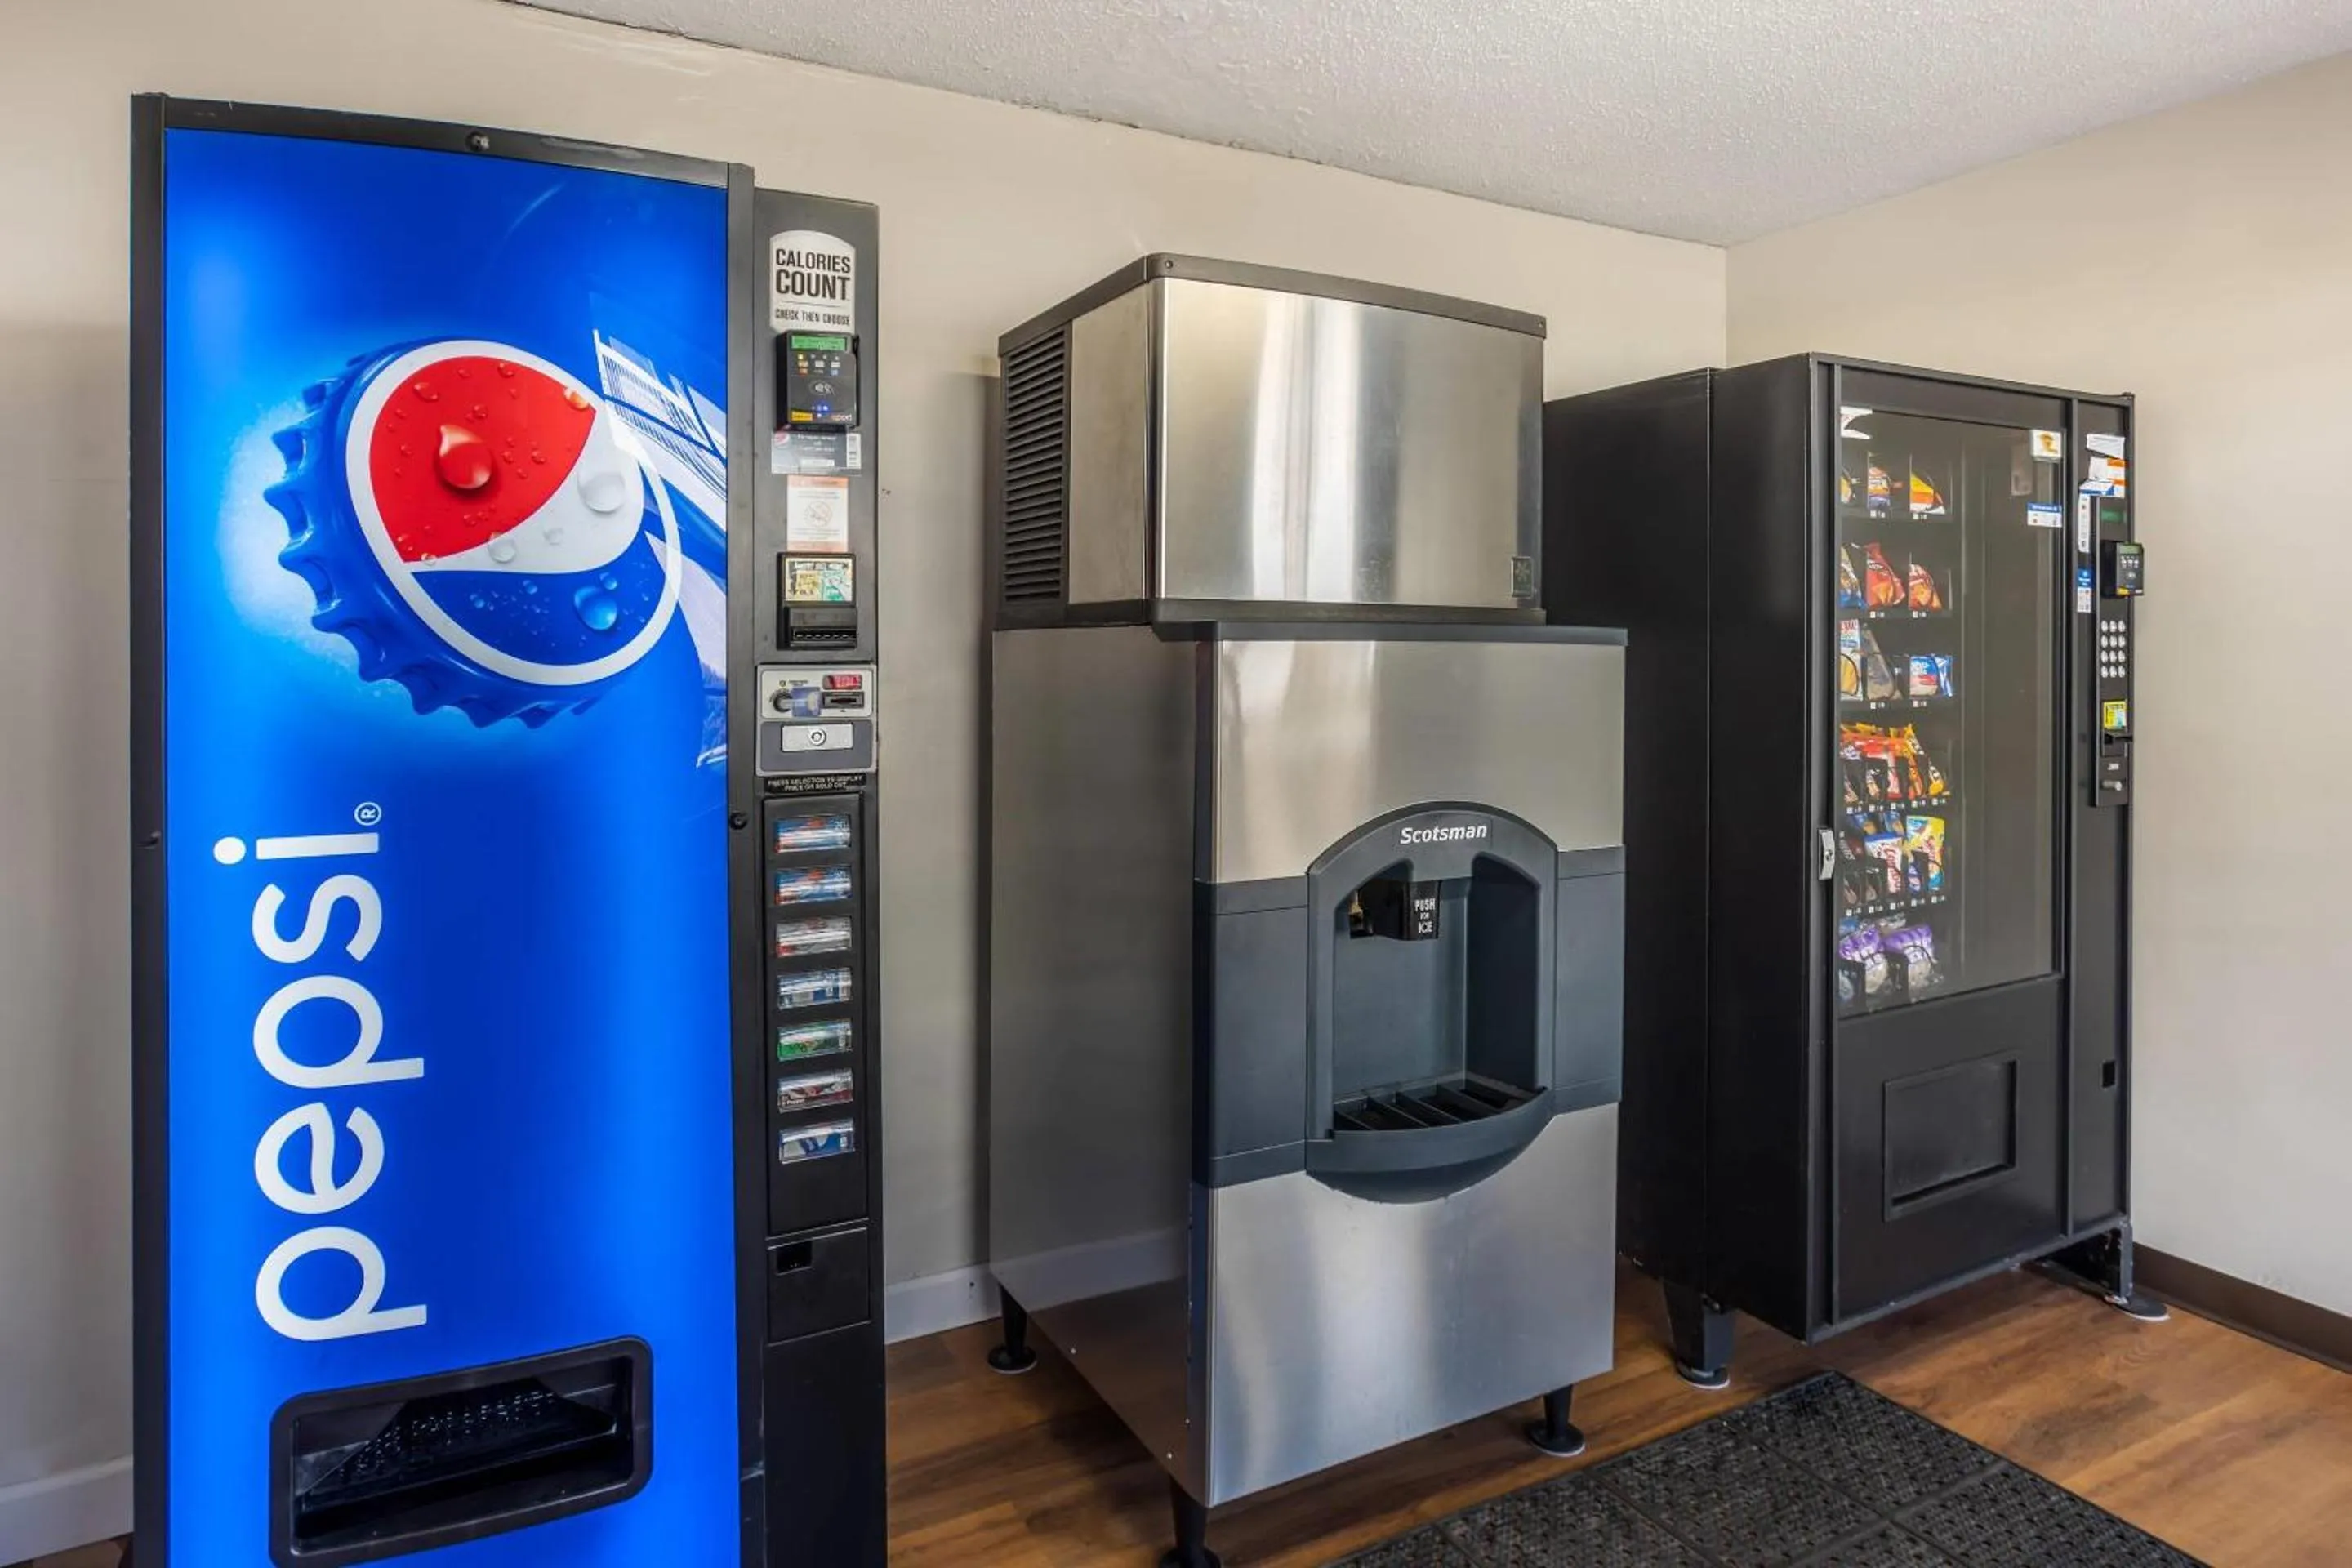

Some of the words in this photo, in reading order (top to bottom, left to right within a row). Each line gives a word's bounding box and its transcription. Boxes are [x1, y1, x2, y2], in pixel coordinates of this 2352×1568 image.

[776, 248, 851, 274] CALORIES
[776, 270, 851, 301] COUNT
[775, 308, 799, 321] CHECK
[802, 310, 820, 323] THEN
[823, 313, 850, 326] CHOOSE
[1400, 825, 1487, 844] Scotsman
[1414, 898, 1436, 911] PUSH
[1418, 921, 1433, 934] ICE
[213, 831, 427, 1341] pepsi
